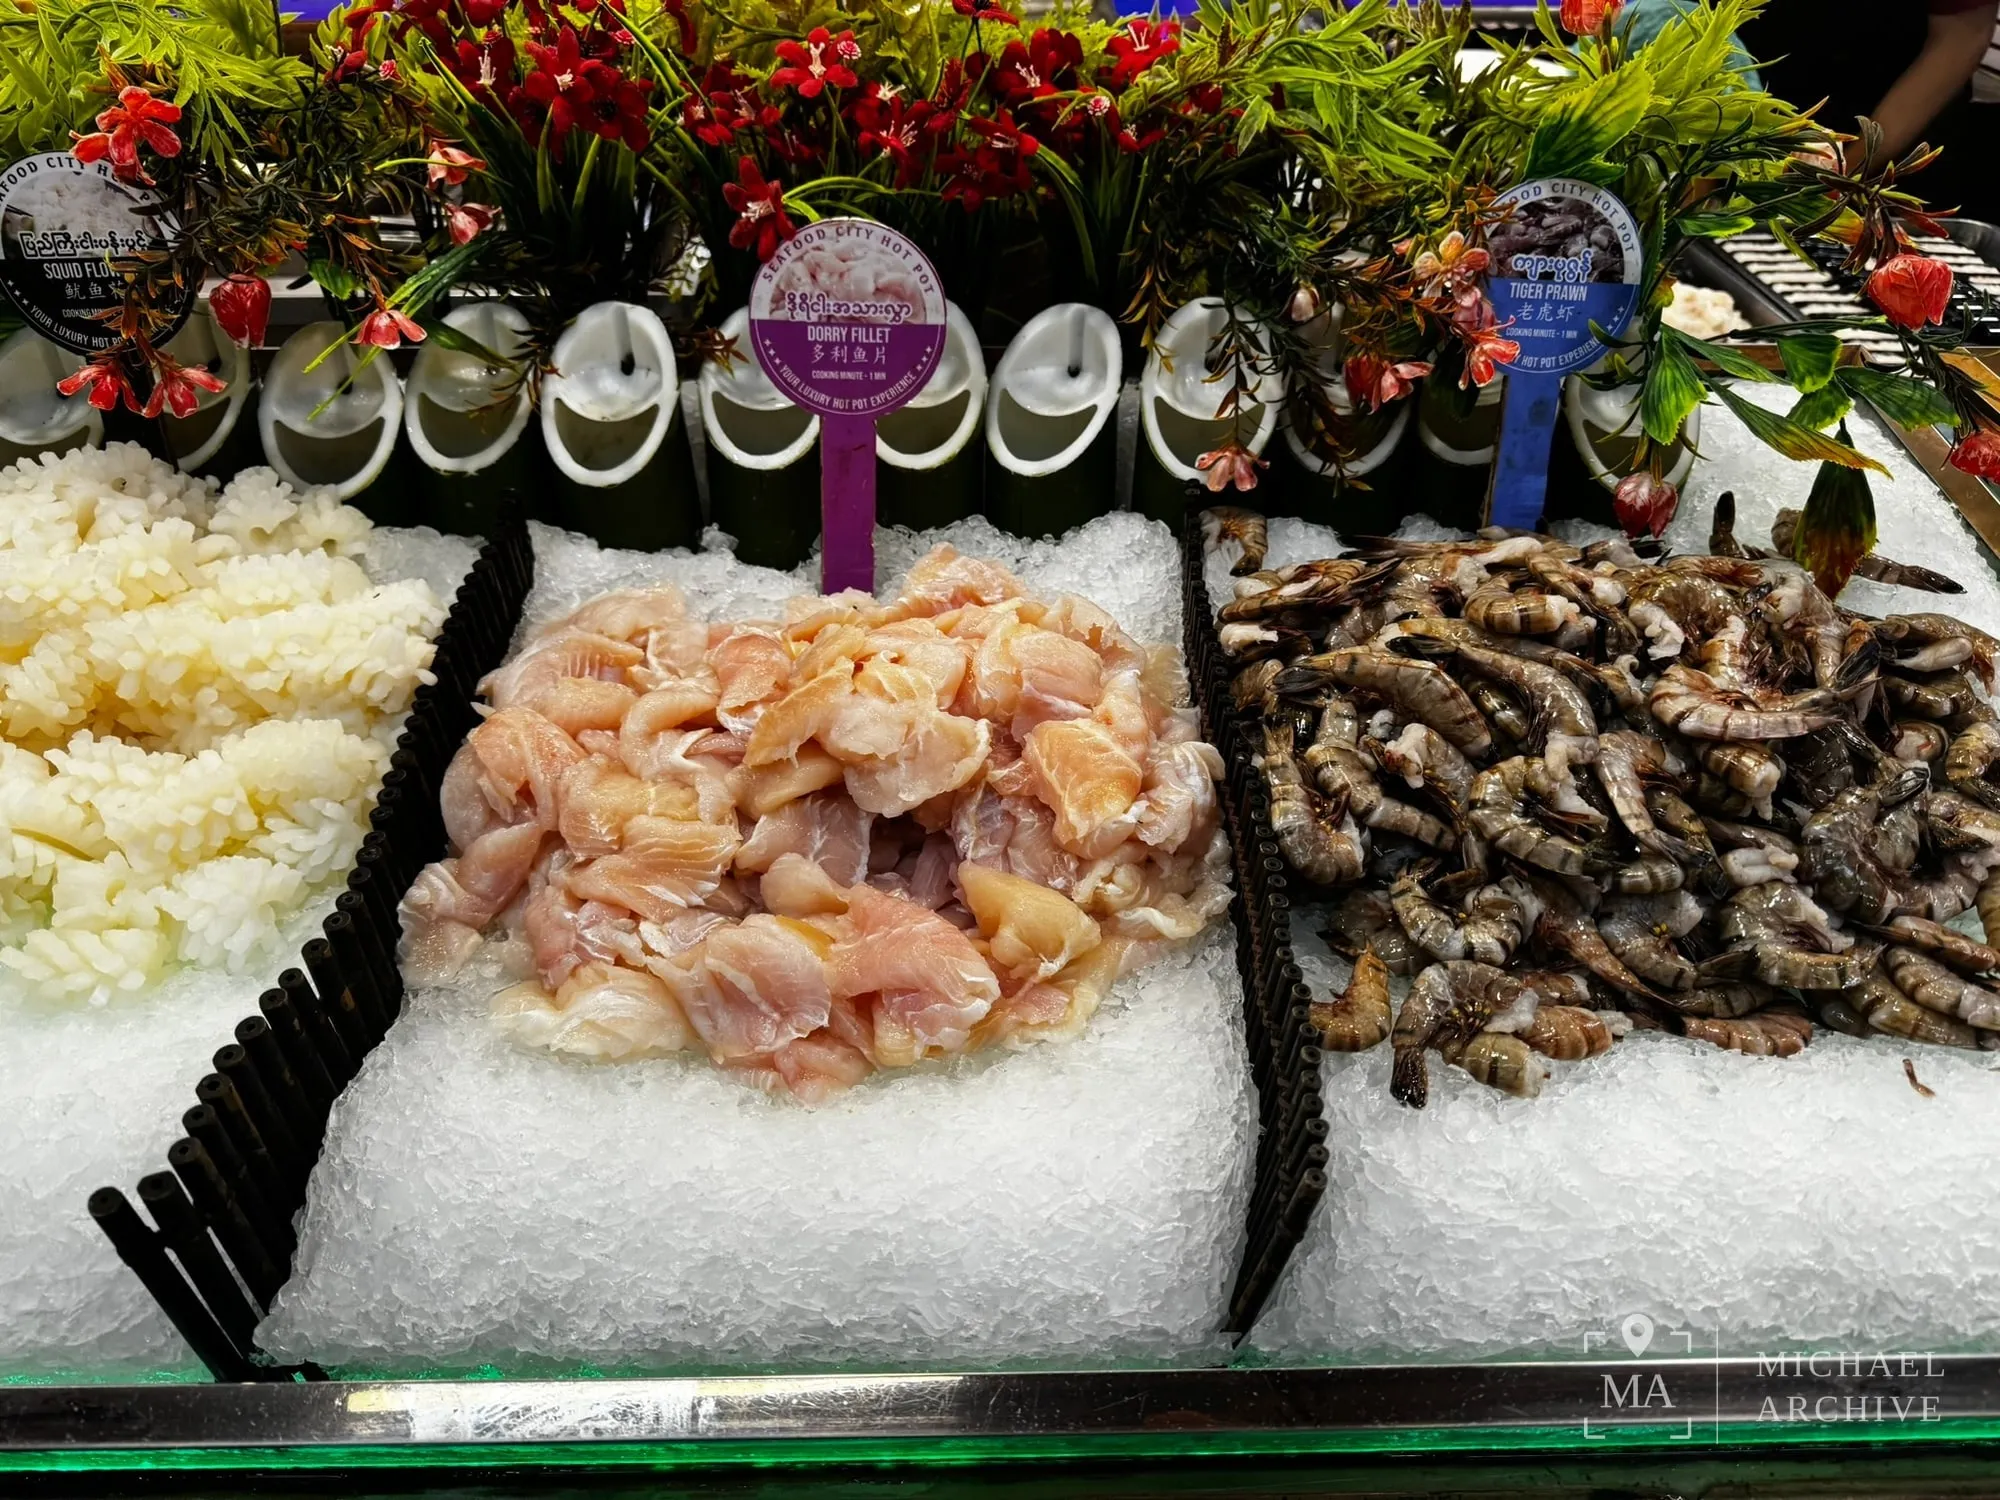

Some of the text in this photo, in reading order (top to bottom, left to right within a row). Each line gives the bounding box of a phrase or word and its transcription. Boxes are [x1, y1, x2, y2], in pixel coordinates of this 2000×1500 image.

[0, 156, 85, 203] AFOOD CITY
[1551, 182, 1635, 252] CITY HOT POT
[763, 225, 935, 294] SEAFOOD CITY HOT POT
[43, 261, 121, 281] SQUID FLO
[1510, 282, 1588, 301] TIGER PRAWN
[61, 308, 91, 319] COOKING
[1517, 302, 1575, 322] 老虎虾
[30, 304, 53, 327] YOUR
[53, 321, 89, 346] LUXURY
[91, 335, 110, 348] HOT
[807, 325, 891, 344] DORRY FILLET
[1506, 327, 1532, 337] COOKING
[1532, 328, 1555, 338] MINUTE
[1566, 330, 1578, 339] MIN
[811, 345, 887, 365] 多利鱼片
[1521, 355, 1538, 367] HOT
[1540, 356, 1556, 368] POT
[1558, 335, 1600, 366] EXPERIEN
[812, 370, 839, 380] COOKING
[840, 370, 864, 380] MINUTE
[874, 371, 887, 381] MIN
[780, 364, 917, 410] YOUR LUXURY HOT POT EXPERIENCE
